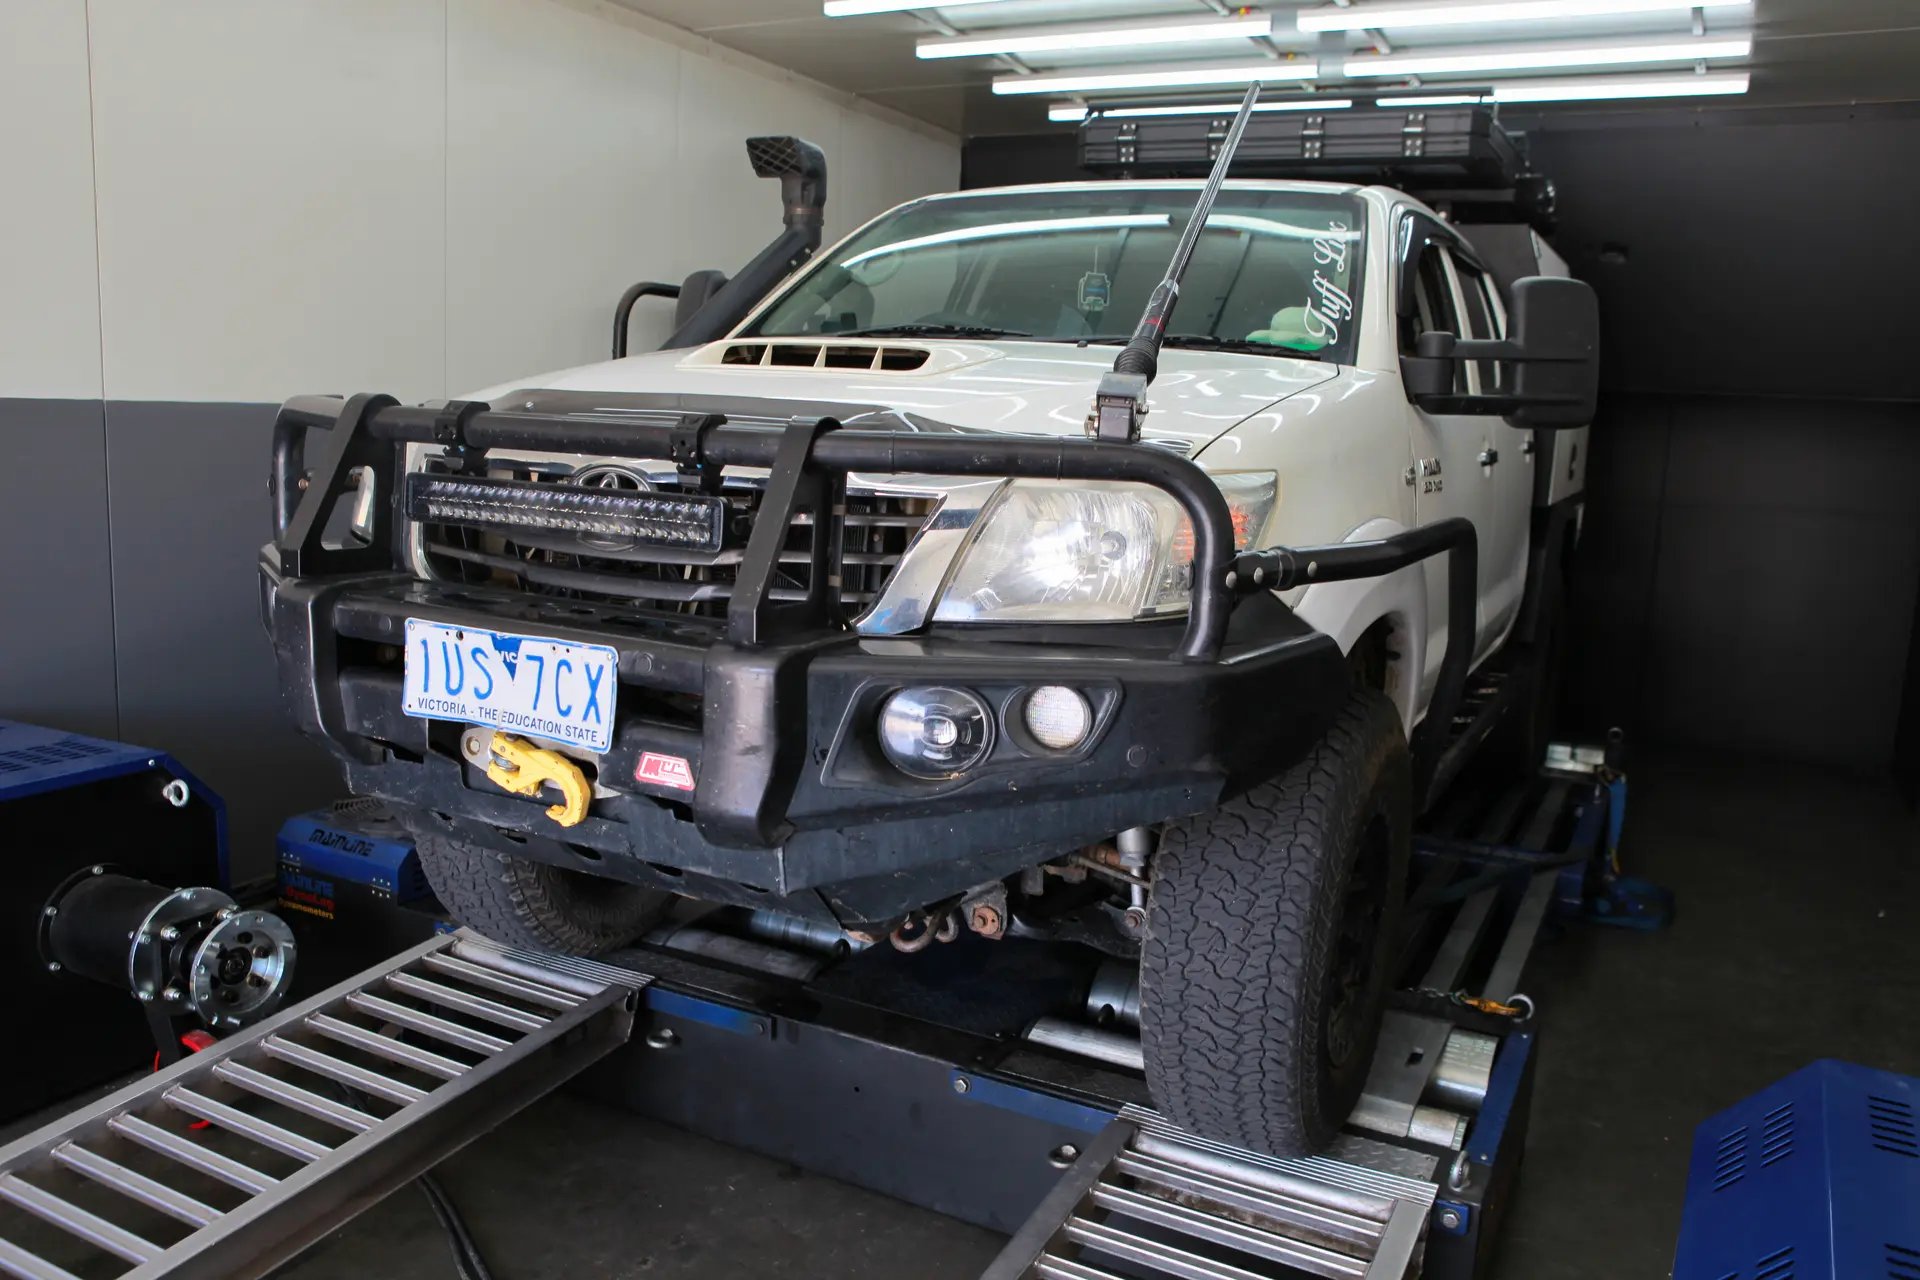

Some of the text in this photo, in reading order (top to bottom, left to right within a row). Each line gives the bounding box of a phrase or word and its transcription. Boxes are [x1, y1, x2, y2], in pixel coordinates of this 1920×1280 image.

[1304, 269, 1353, 345] Tuff
[420, 638, 604, 725] 1US 7CX
[418, 697, 467, 716] VICTORIA
[478, 706, 498, 721] THE
[501, 710, 562, 735] EDUCATION
[565, 725, 598, 743] STATE
